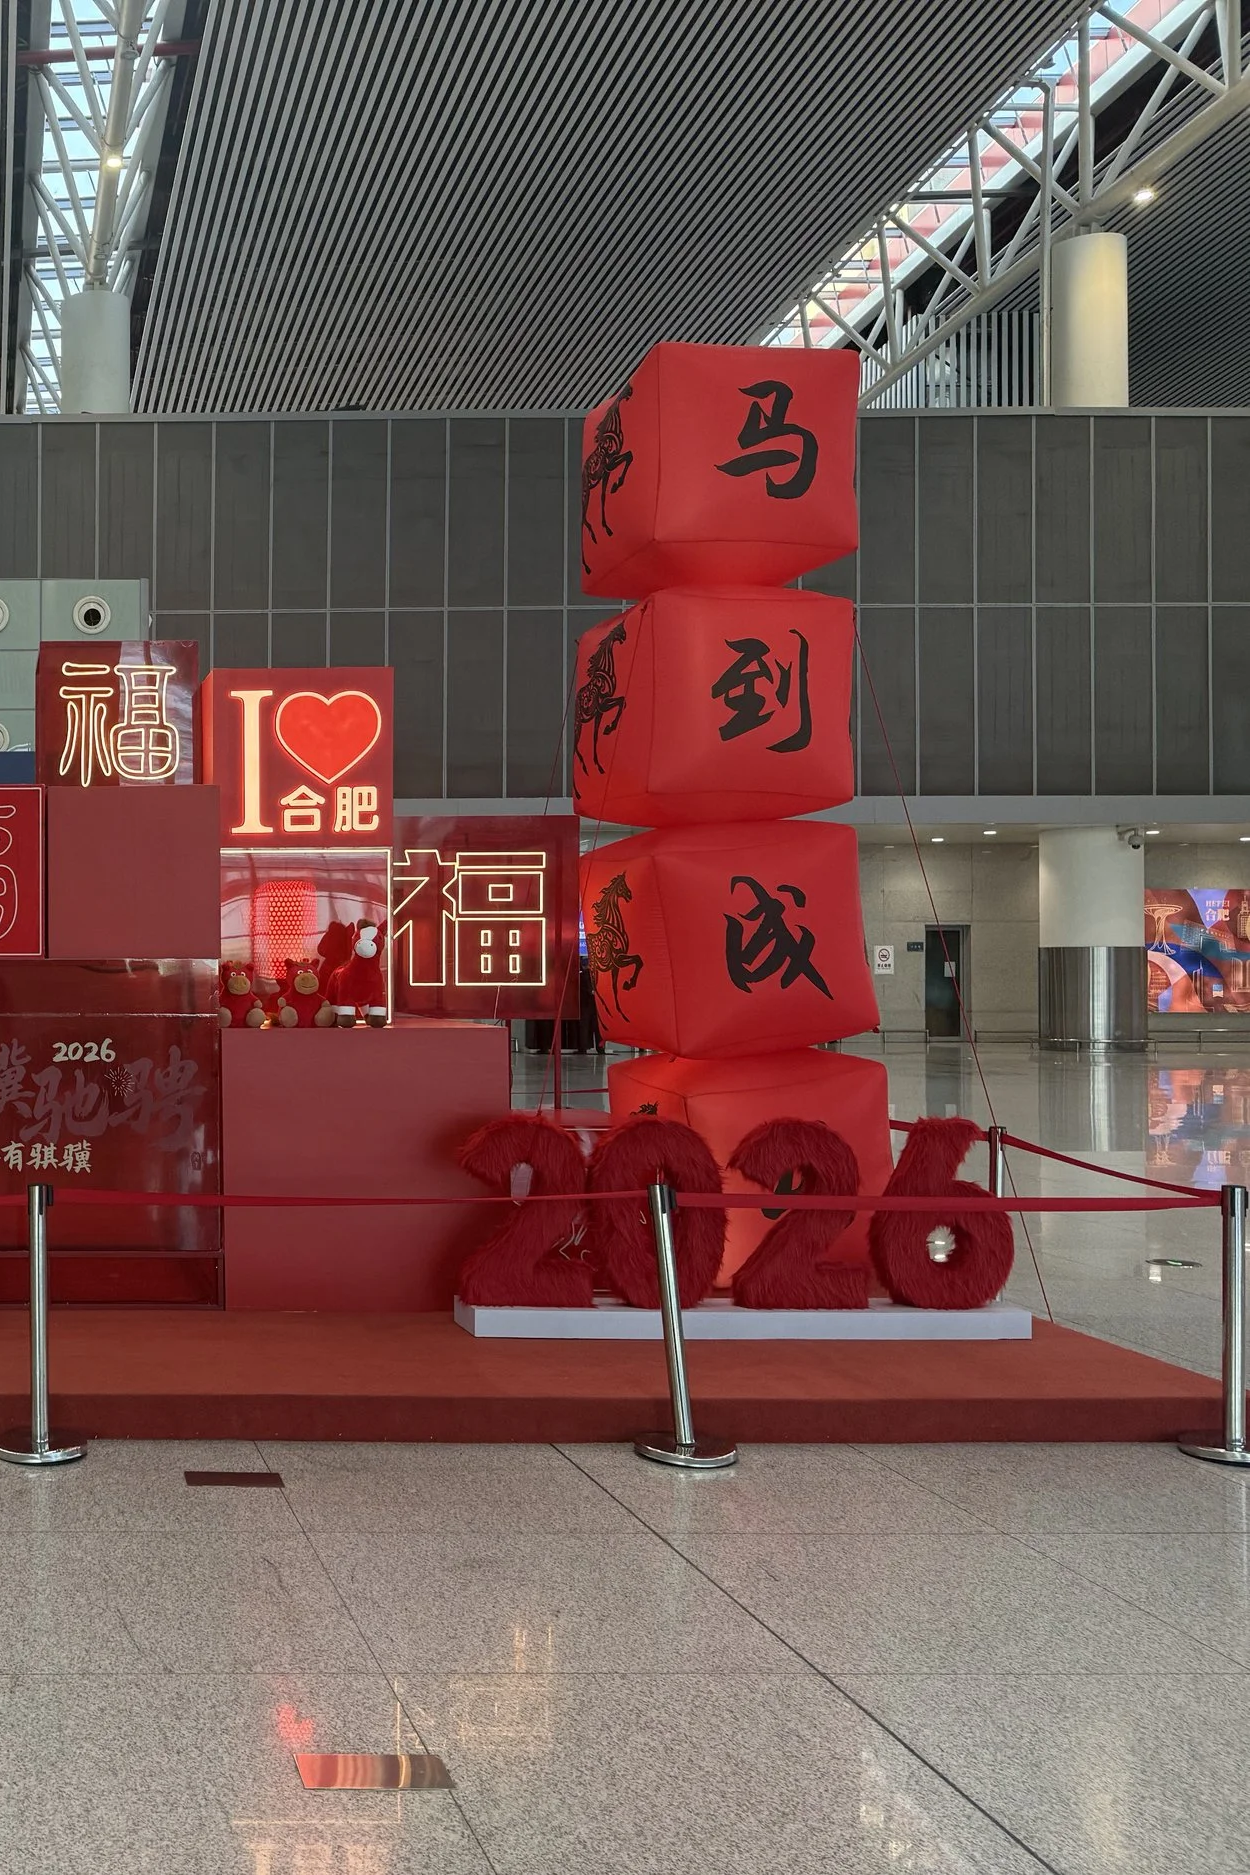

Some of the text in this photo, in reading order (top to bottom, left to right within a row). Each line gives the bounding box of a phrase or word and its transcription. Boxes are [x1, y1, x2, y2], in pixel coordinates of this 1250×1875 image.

[59, 661, 180, 787] 福
[230, 690, 273, 834] I
[280, 784, 379, 832] 合肥
[393, 849, 546, 986] 福
[52, 1038, 116, 1063] 2026
[455, 1114, 1015, 1309] 2026
